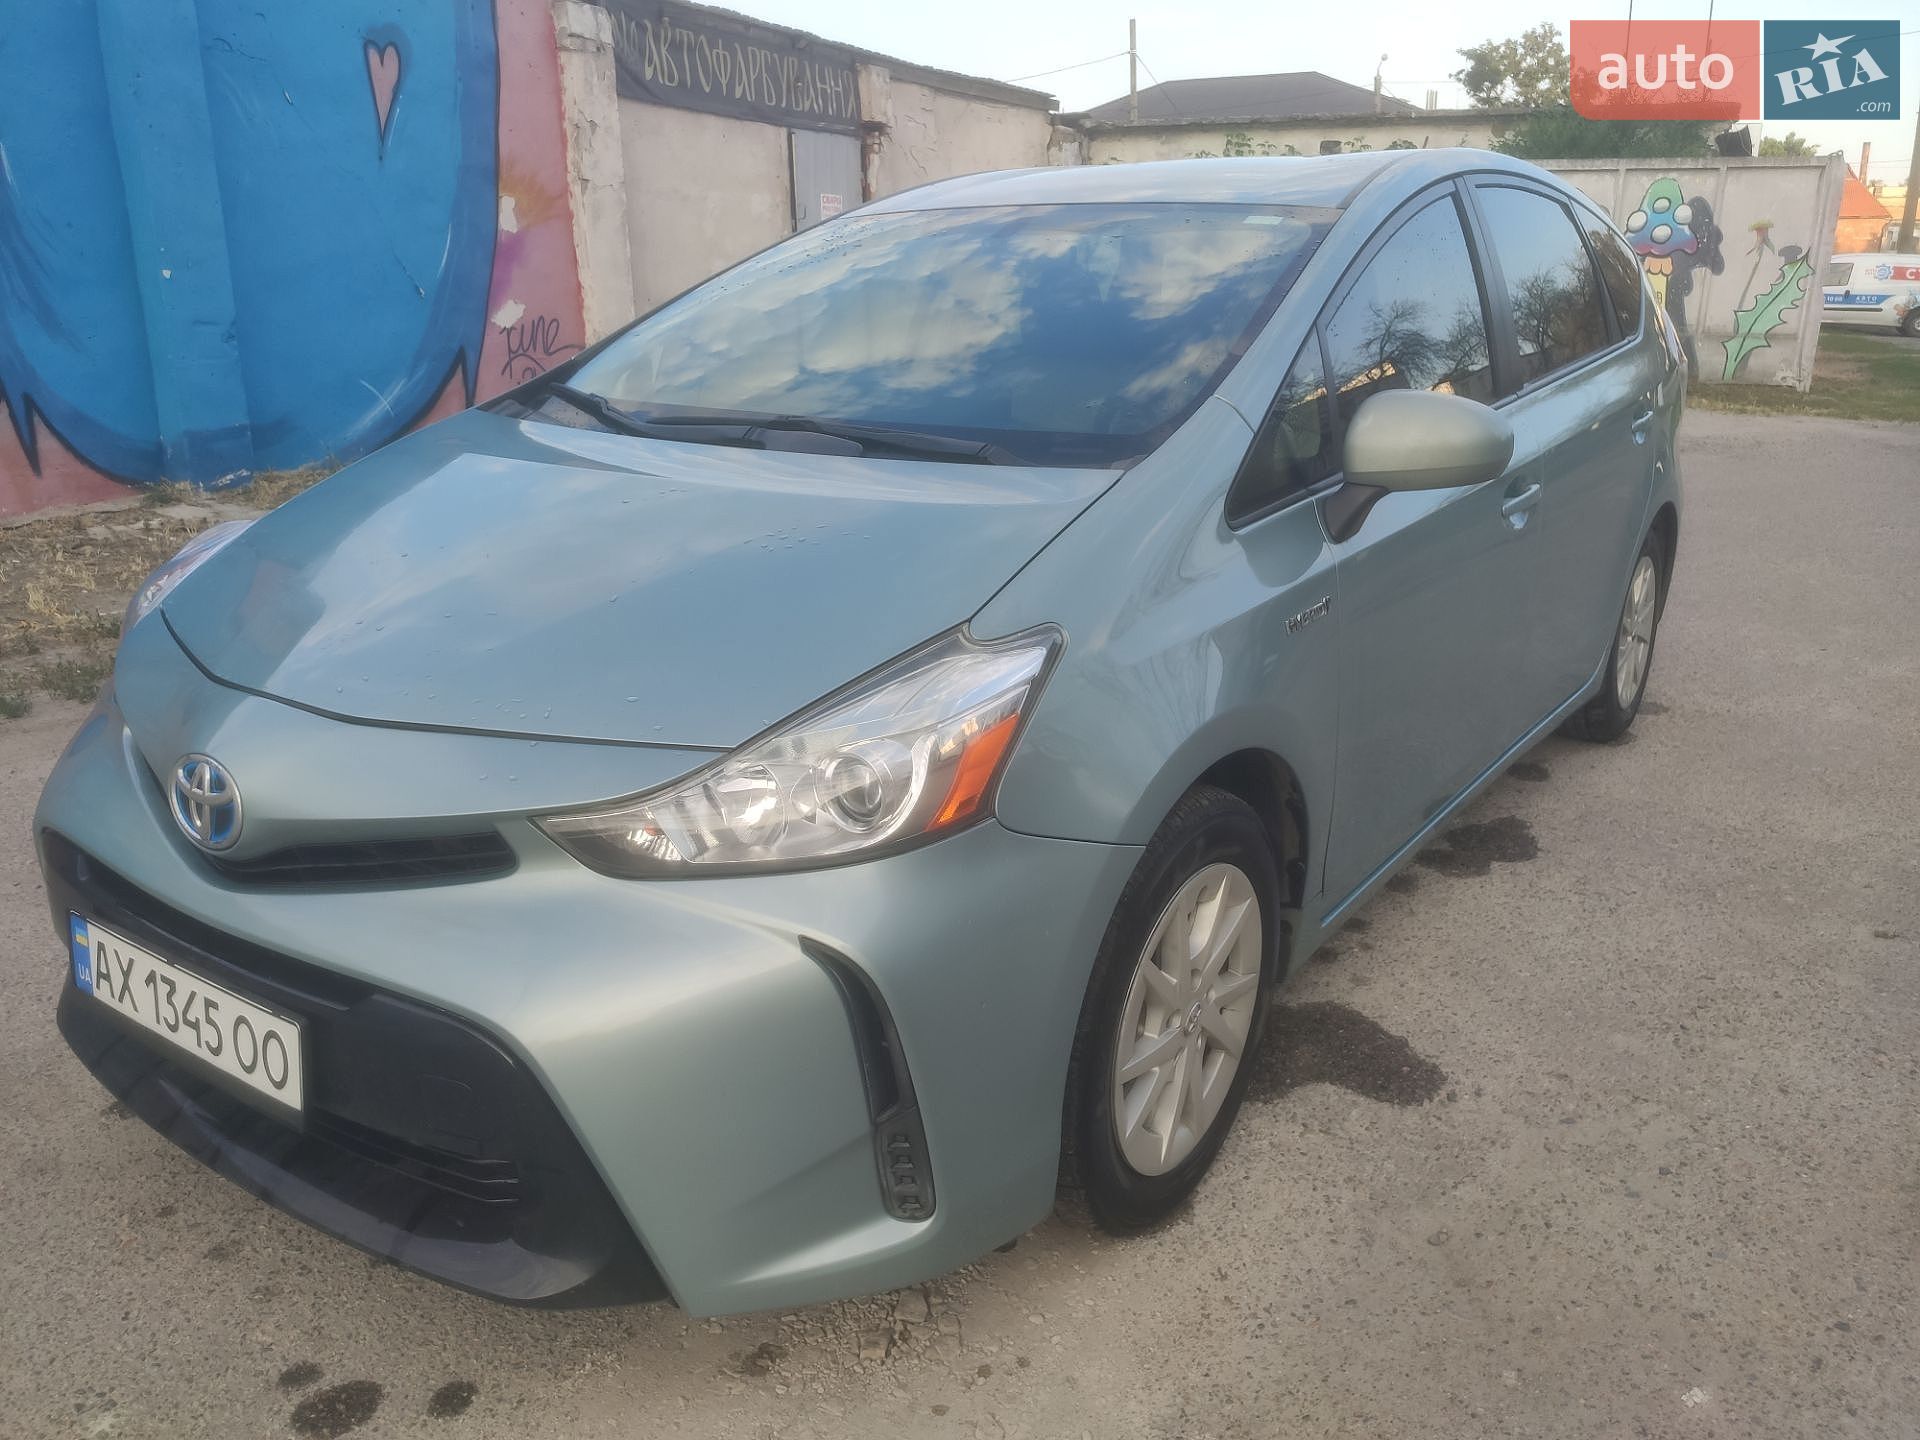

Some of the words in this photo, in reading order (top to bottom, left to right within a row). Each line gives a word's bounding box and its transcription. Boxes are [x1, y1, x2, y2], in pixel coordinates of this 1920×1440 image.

[78, 963, 93, 985] UA
[96, 941, 138, 1013] AX
[145, 969, 223, 1057] 1345
[233, 1015, 289, 1090] OO
